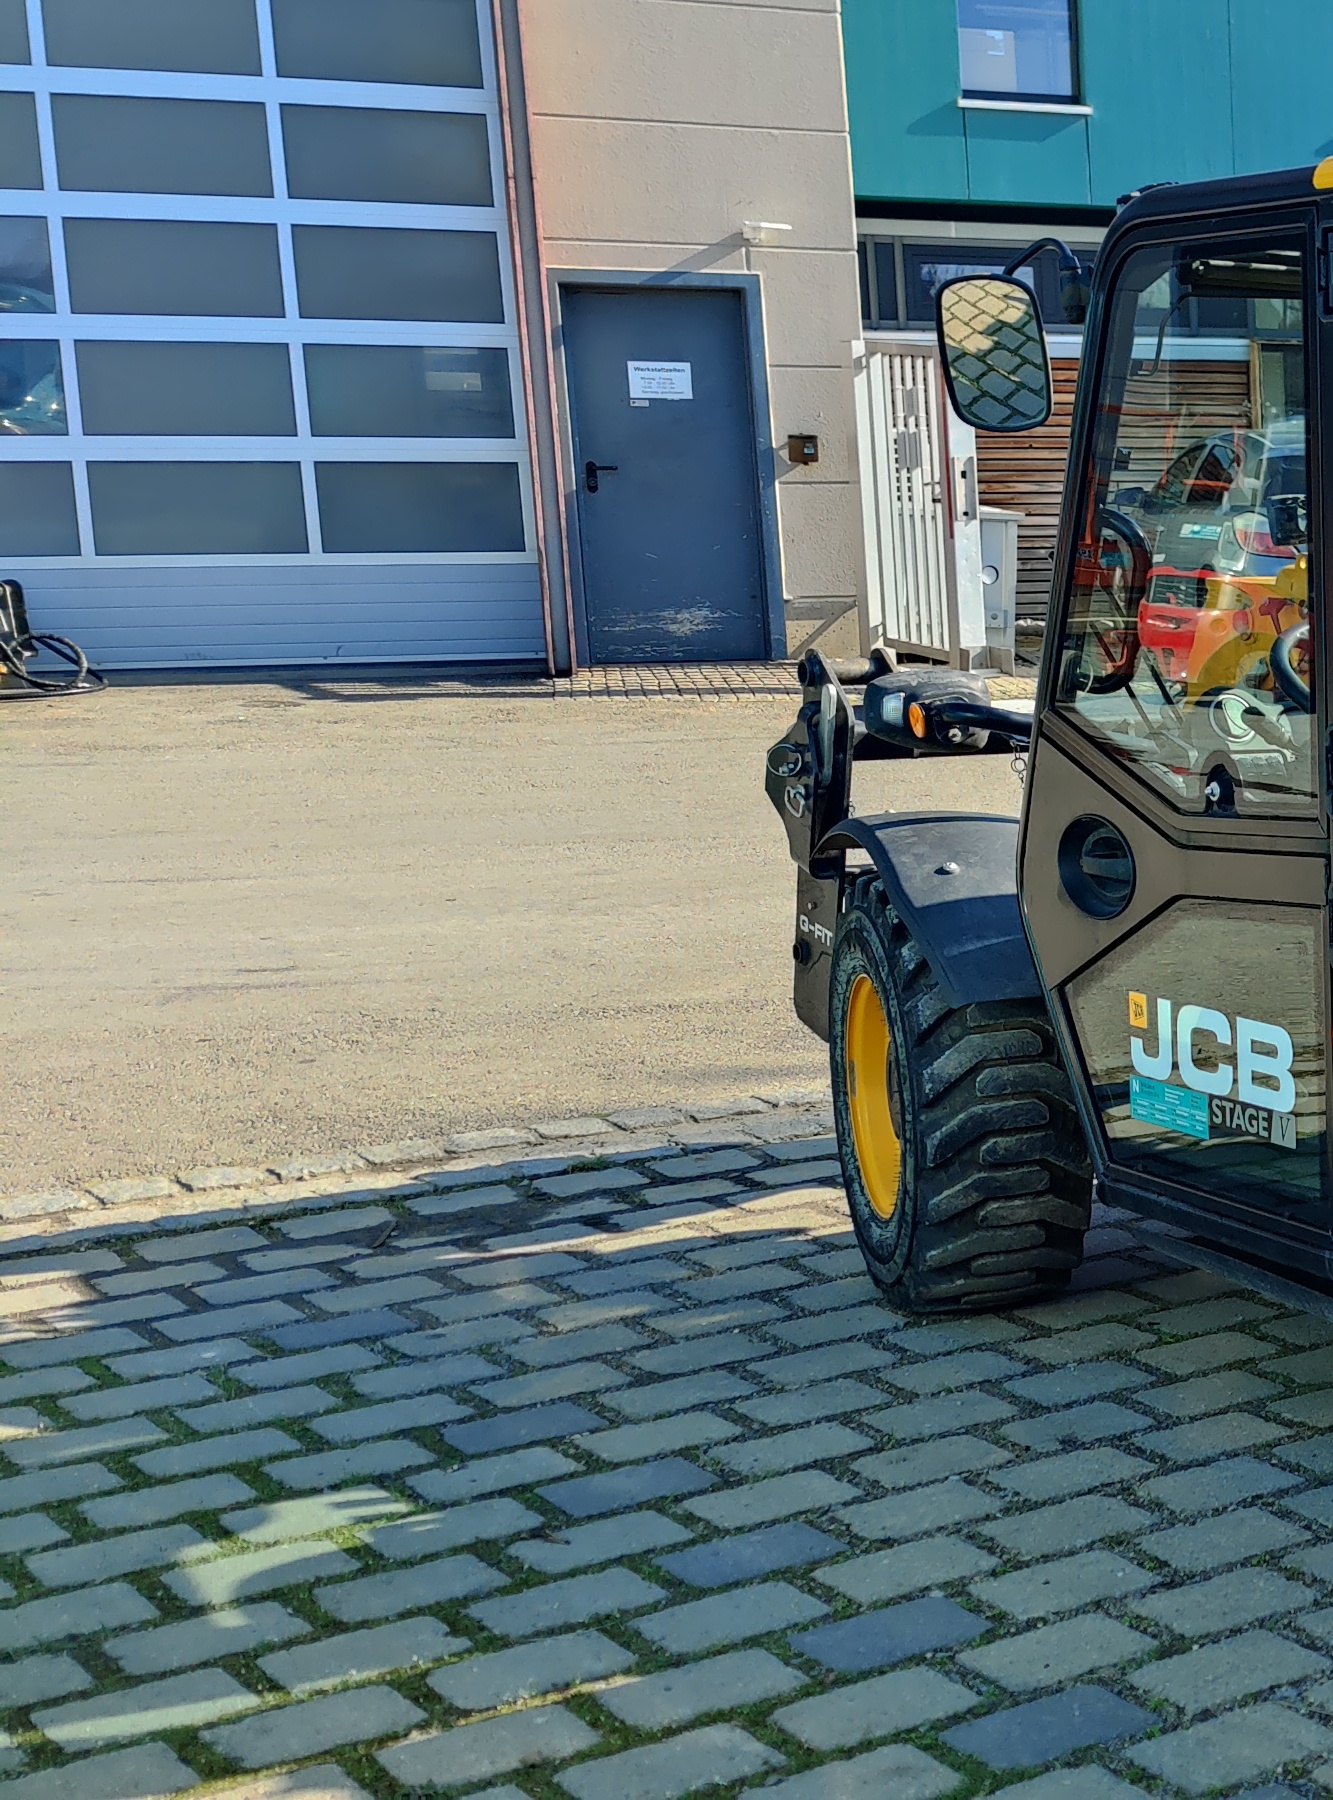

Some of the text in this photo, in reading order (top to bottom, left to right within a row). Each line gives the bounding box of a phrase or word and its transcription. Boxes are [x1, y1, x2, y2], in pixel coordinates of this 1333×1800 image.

[799, 914, 833, 947] Q-FIT
[1130, 997, 1296, 1114] JCB
[1211, 1098, 1269, 1138] STAGE
[1278, 1115, 1290, 1142] V
